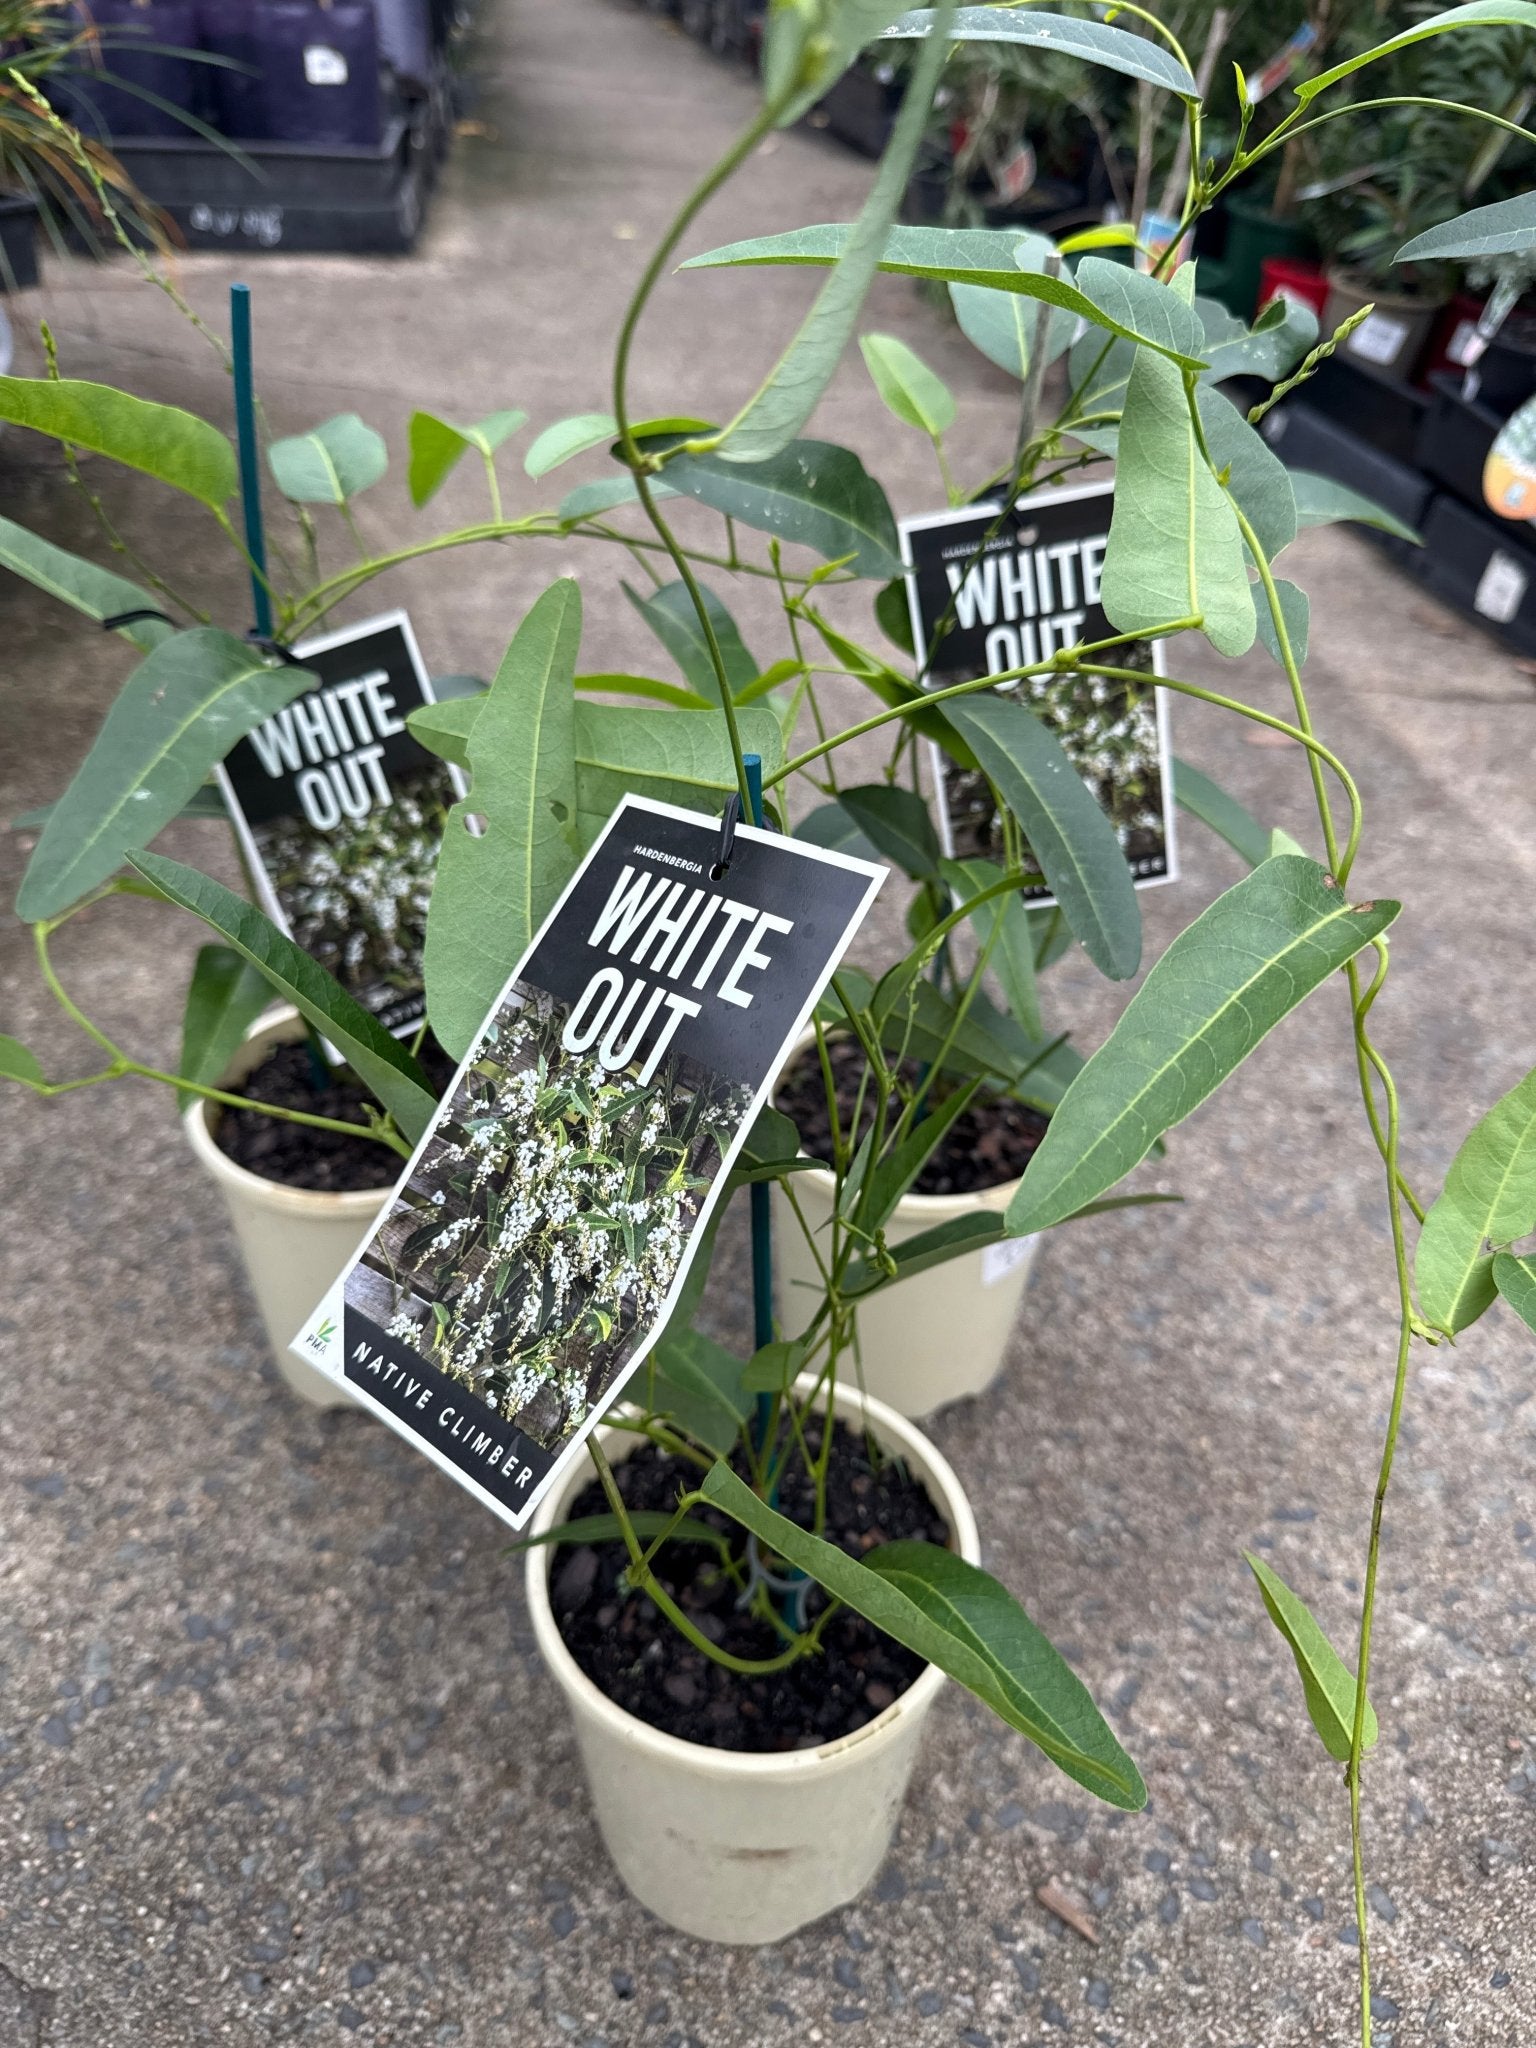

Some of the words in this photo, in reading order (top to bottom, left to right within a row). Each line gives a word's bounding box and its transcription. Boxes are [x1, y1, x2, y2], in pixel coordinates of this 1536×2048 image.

[945, 533, 1108, 630] WHITE
[985, 610, 1087, 692] OUT
[249, 669, 406, 779] WHITE
[295, 743, 394, 831] OUT
[633, 844, 703, 875] HARDENBERGIA
[587, 865, 795, 1009] WHITE
[562, 967, 703, 1088] OUT
[351, 1341, 433, 1410] NATIVE
[438, 1407, 533, 1489] CLIMBER
